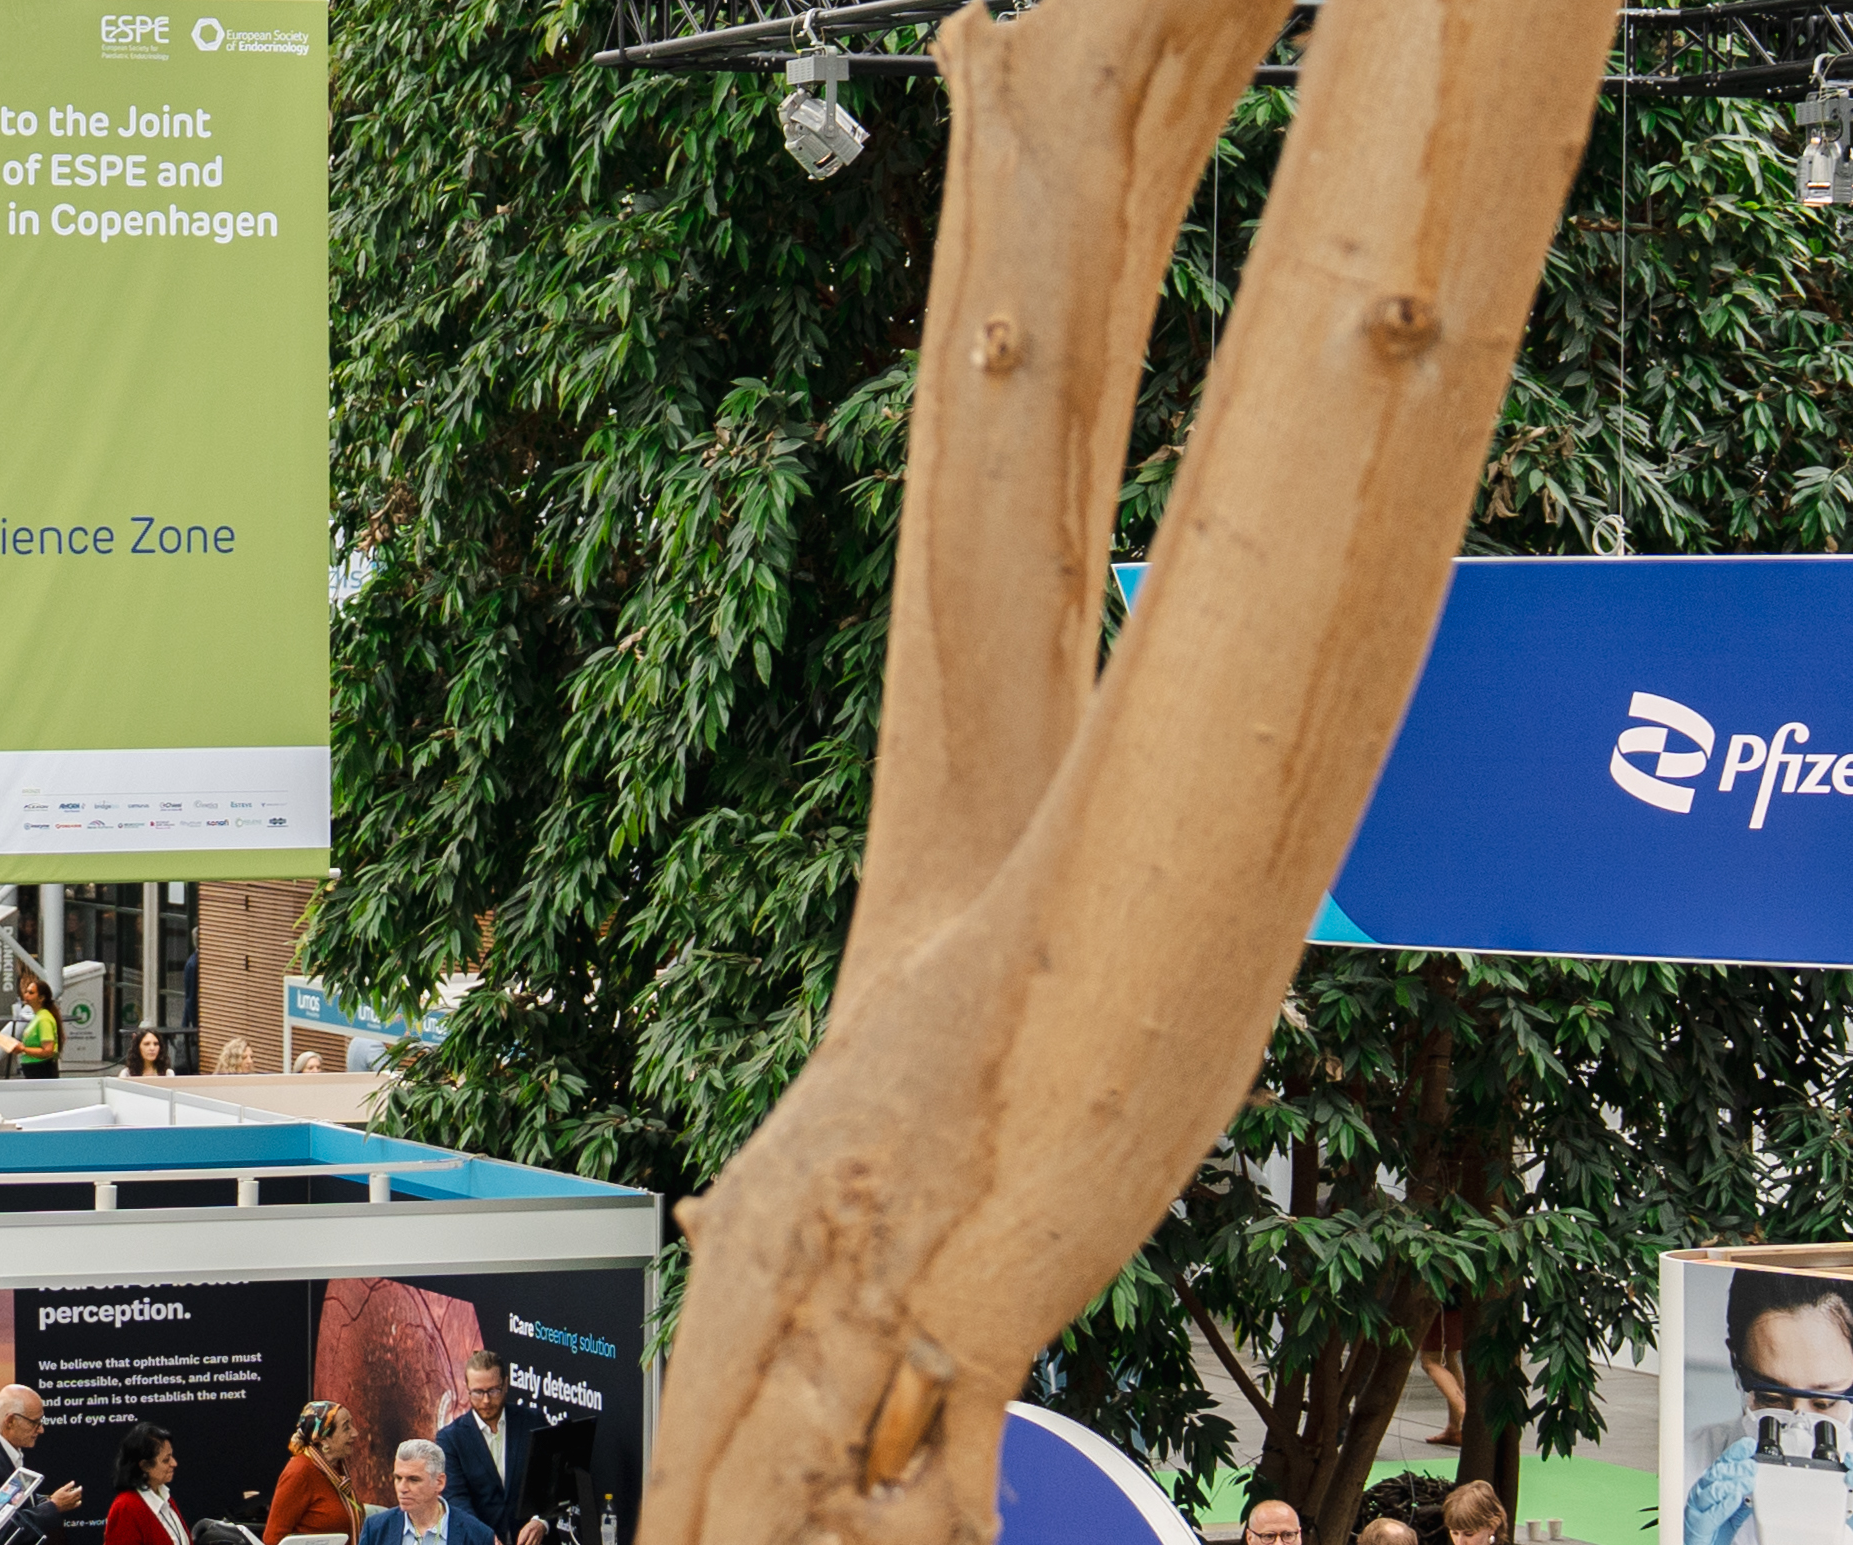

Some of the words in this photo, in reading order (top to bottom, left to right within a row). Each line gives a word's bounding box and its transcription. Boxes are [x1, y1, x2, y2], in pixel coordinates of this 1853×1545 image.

[101, 15, 169, 43] ESPE
[227, 30, 271, 41] European
[274, 30, 308, 43] Society
[226, 41, 237, 51] of
[239, 41, 309, 55] Endocrinology
[1, 106, 37, 136] to
[50, 104, 109, 137] the
[118, 105, 211, 138] Joint
[3, 153, 42, 185] of
[51, 154, 147, 187] ESPE
[158, 155, 222, 187] and
[9, 202, 39, 235] in
[51, 203, 277, 244] Copenhagen
[131, 517, 235, 554] Zone
[39, 1297, 191, 1330] perception.
[509, 1313, 534, 1337] iCare
[535, 1321, 578, 1354] Screening
[580, 1333, 616, 1359] solution
[510, 1362, 541, 1399] Early
[543, 1371, 603, 1411] detection
